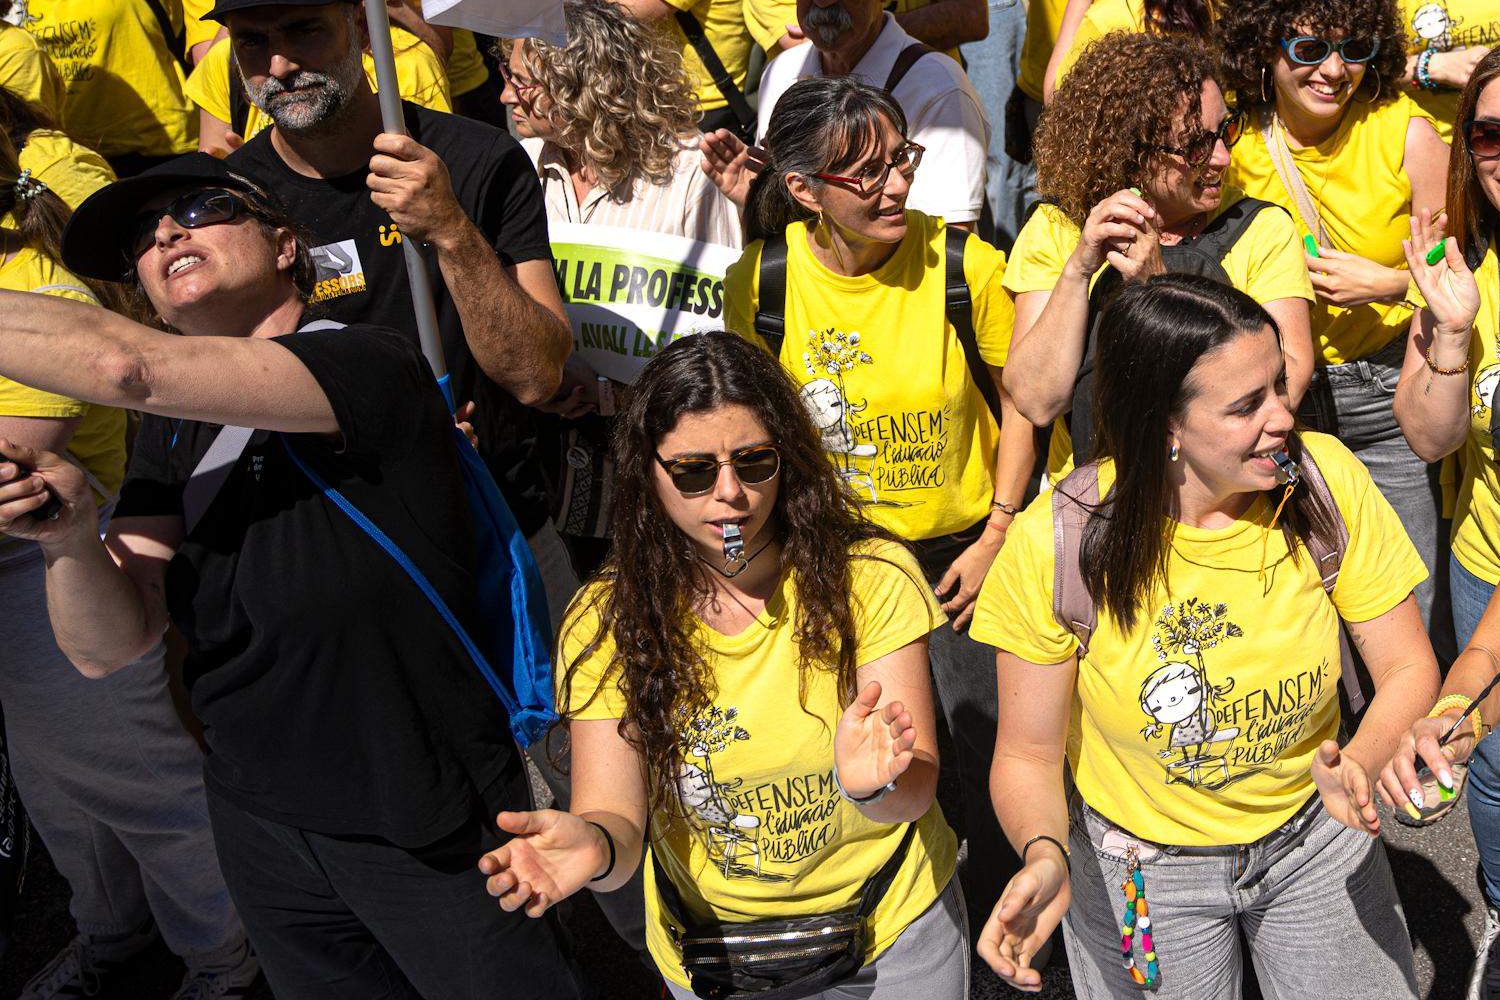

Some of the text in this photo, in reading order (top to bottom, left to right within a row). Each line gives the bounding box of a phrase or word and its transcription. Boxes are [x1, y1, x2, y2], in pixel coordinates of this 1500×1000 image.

[573, 270, 602, 301] LA
[581, 322, 628, 356] AVALL
[854, 409, 942, 444] DEFENSEM
[1217, 665, 1322, 726] DEFENSEM
[731, 769, 834, 814] DEFENSEM
